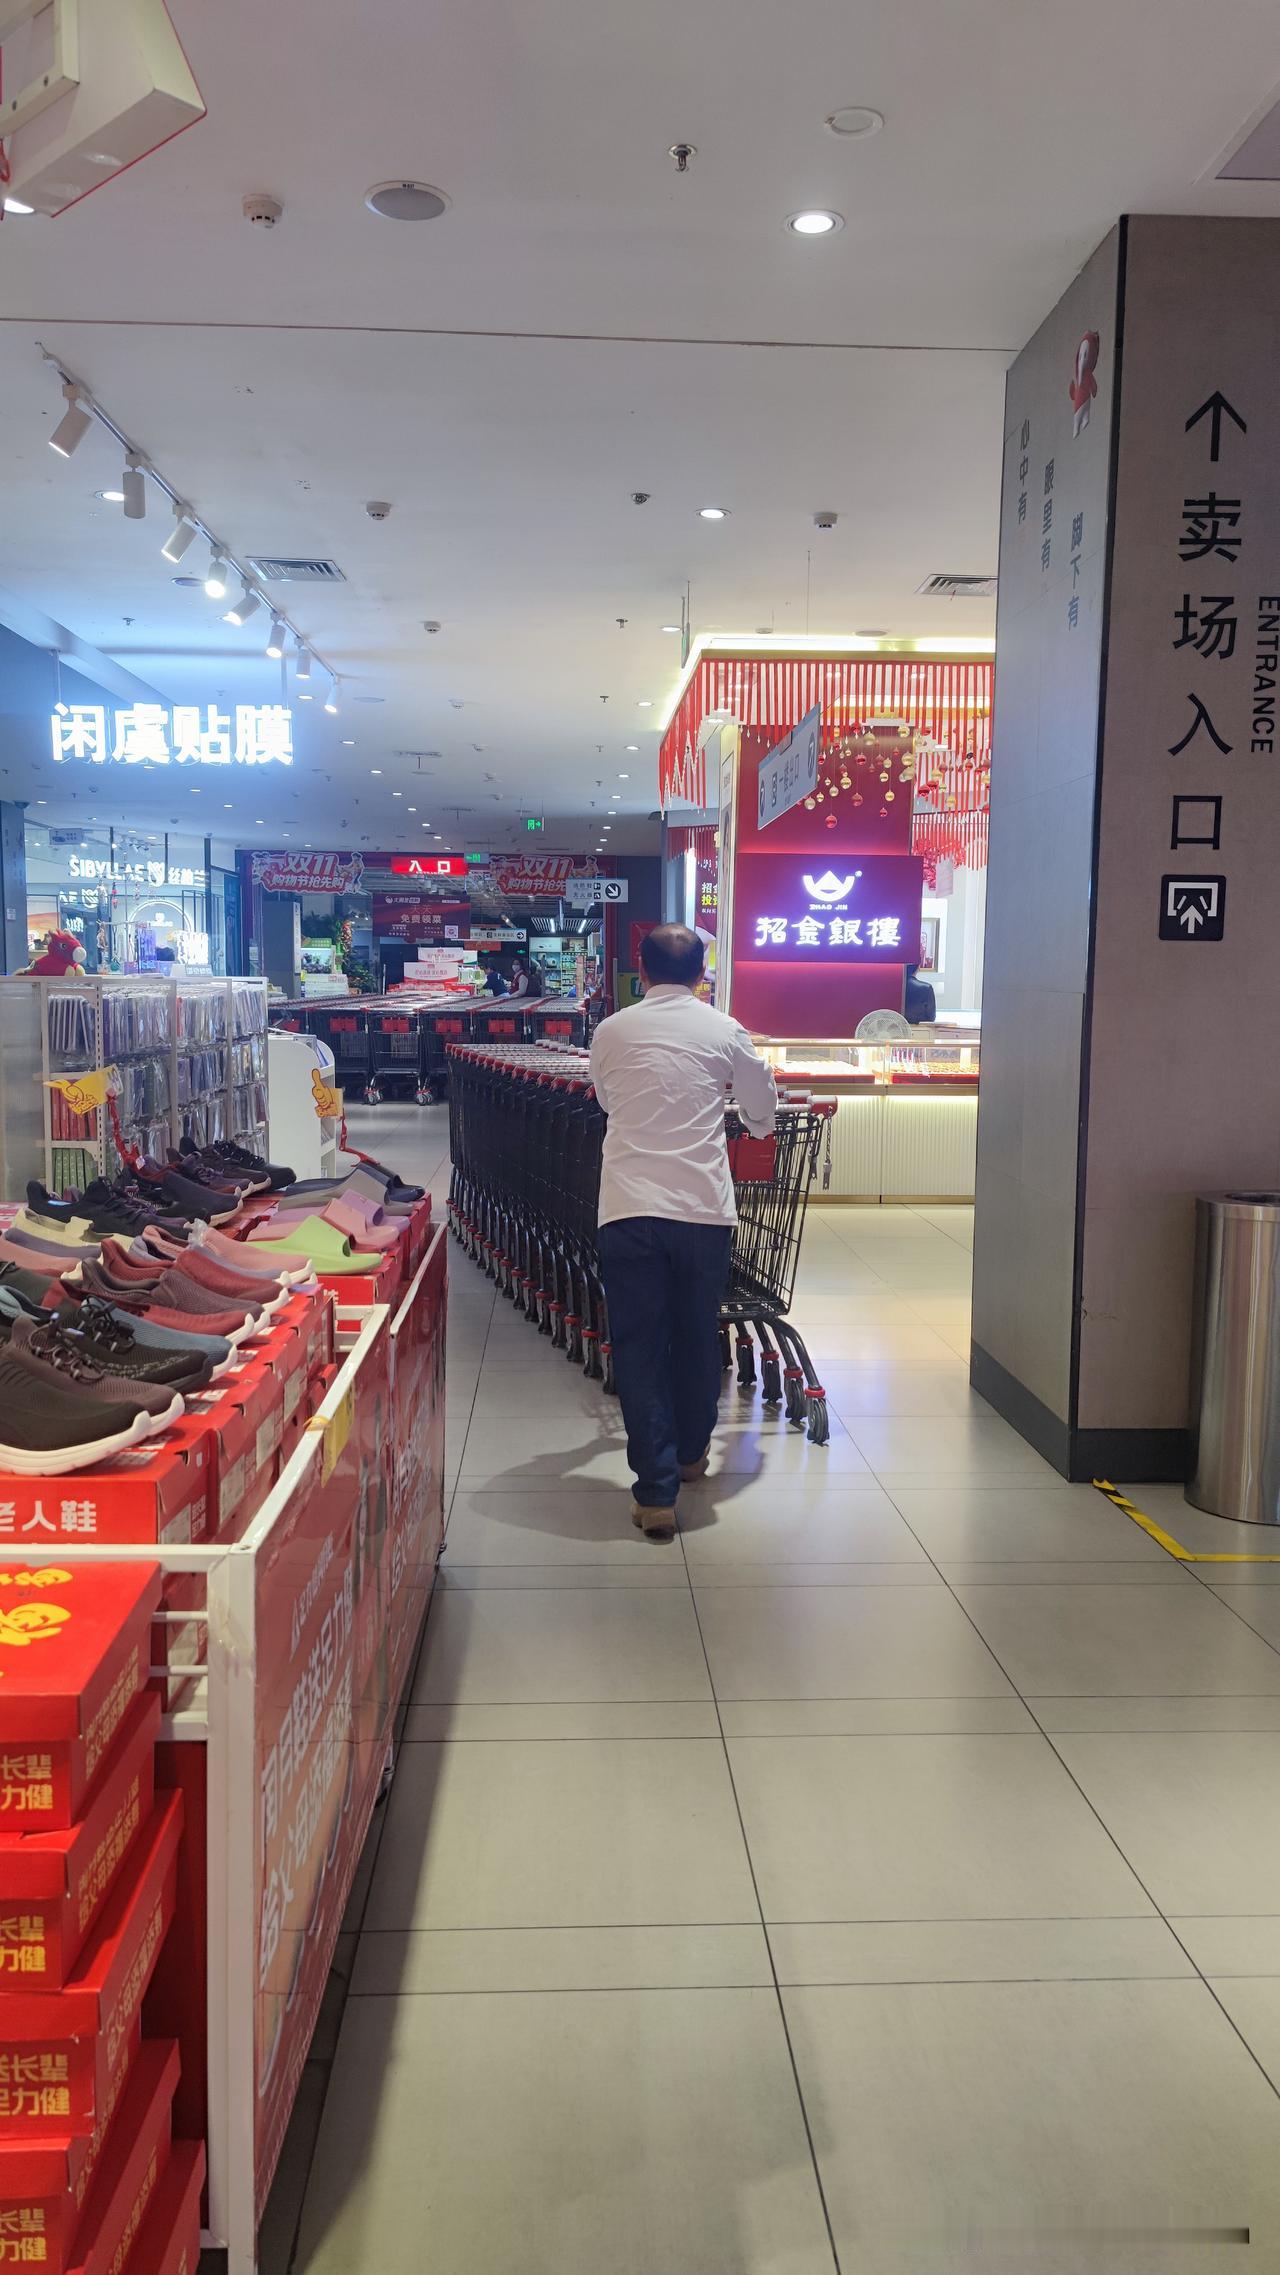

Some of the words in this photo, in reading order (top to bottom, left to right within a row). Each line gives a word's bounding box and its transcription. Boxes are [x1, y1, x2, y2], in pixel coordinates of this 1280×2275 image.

[1041, 458, 1055, 572] 眼里有
[1067, 512, 1084, 631] 脚下有
[1167, 491, 1243, 851] 卖场入口
[1250, 596, 1280, 753] ENTRANCE
[283, 853, 335, 875] 双11
[408, 860, 451, 873] 入口
[519, 856, 570, 878] 双11
[270, 874, 345, 890] 购物节抢先购
[0, 1783, 53, 1811] 力健
